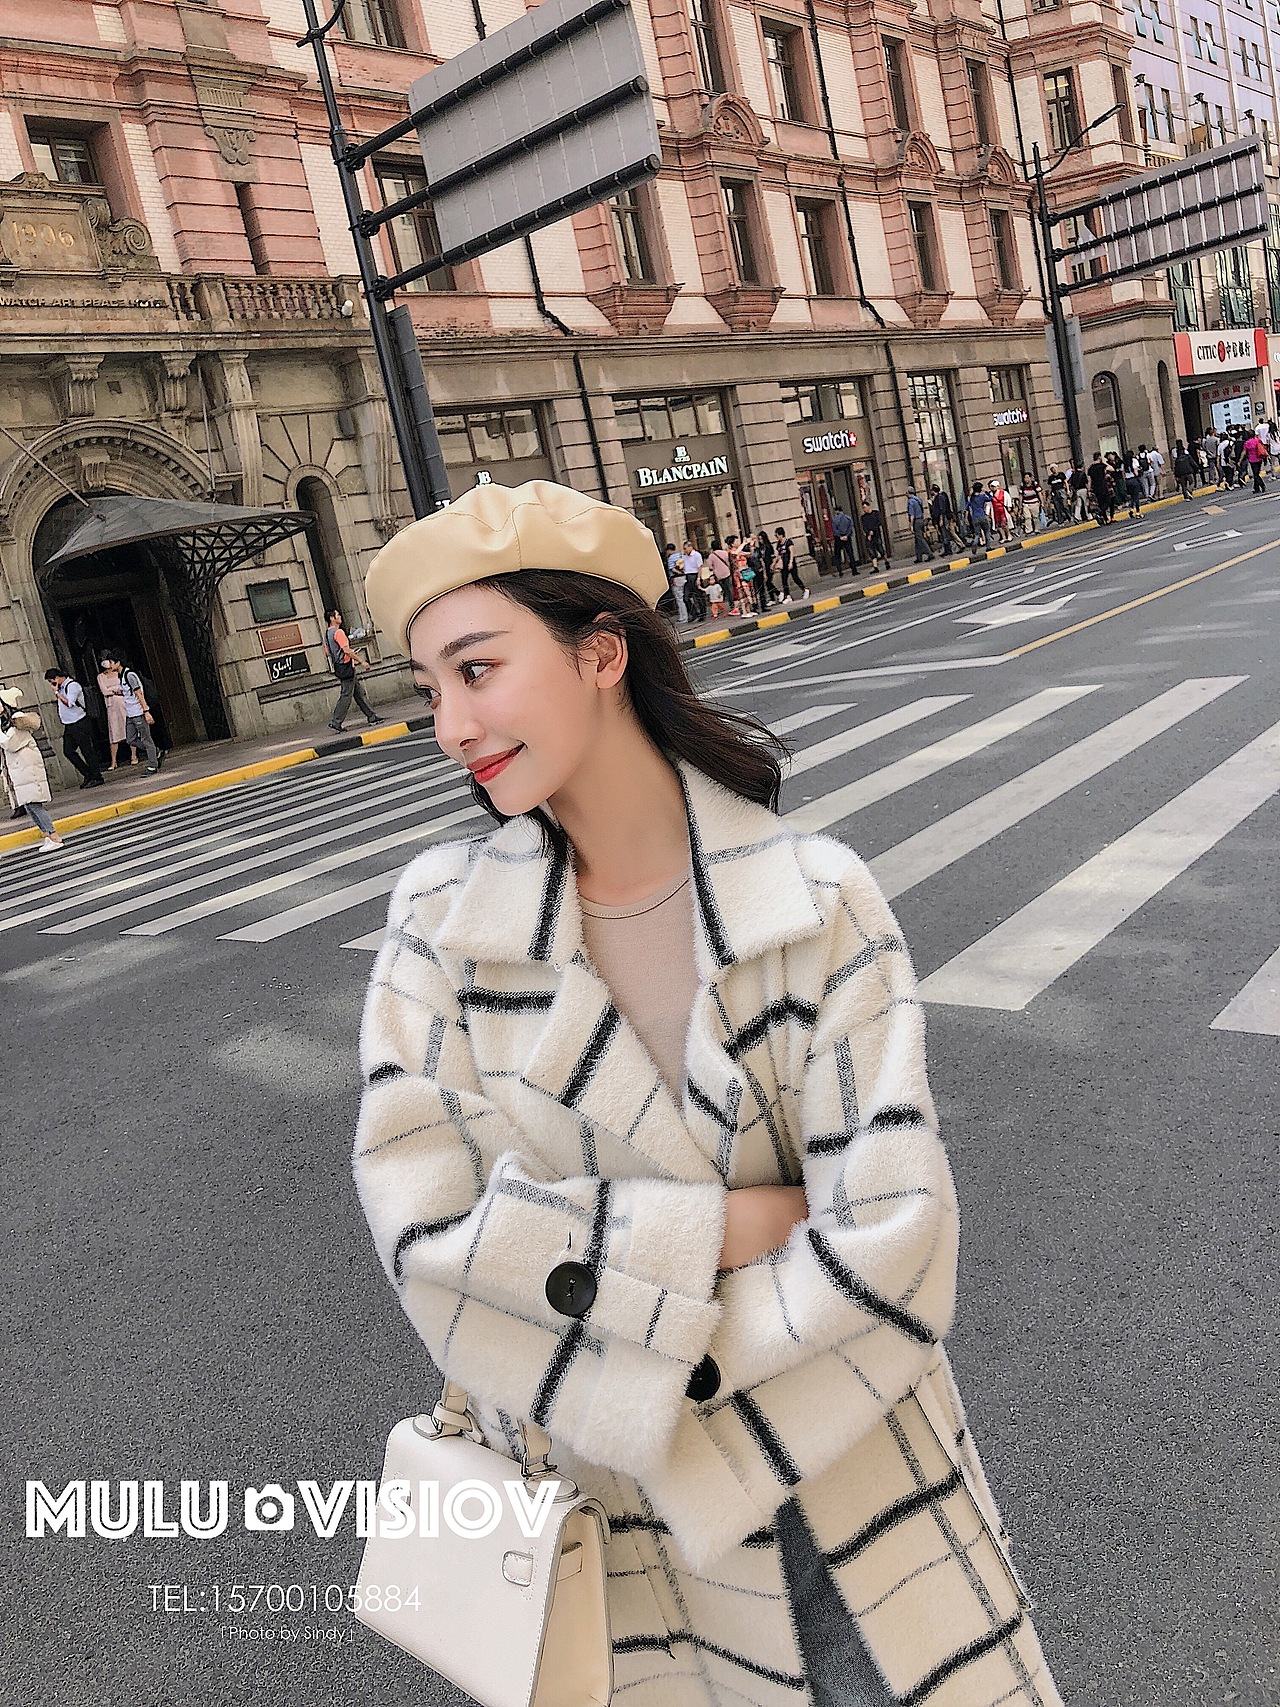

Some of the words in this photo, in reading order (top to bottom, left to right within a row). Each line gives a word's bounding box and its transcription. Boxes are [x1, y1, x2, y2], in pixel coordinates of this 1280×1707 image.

[12, 221, 75, 248] 1906
[1197, 345, 1217, 360] CITIC
[993, 409, 1023, 426] swatch
[803, 430, 850, 453] swatch
[637, 456, 728, 487] BLANCPAIN
